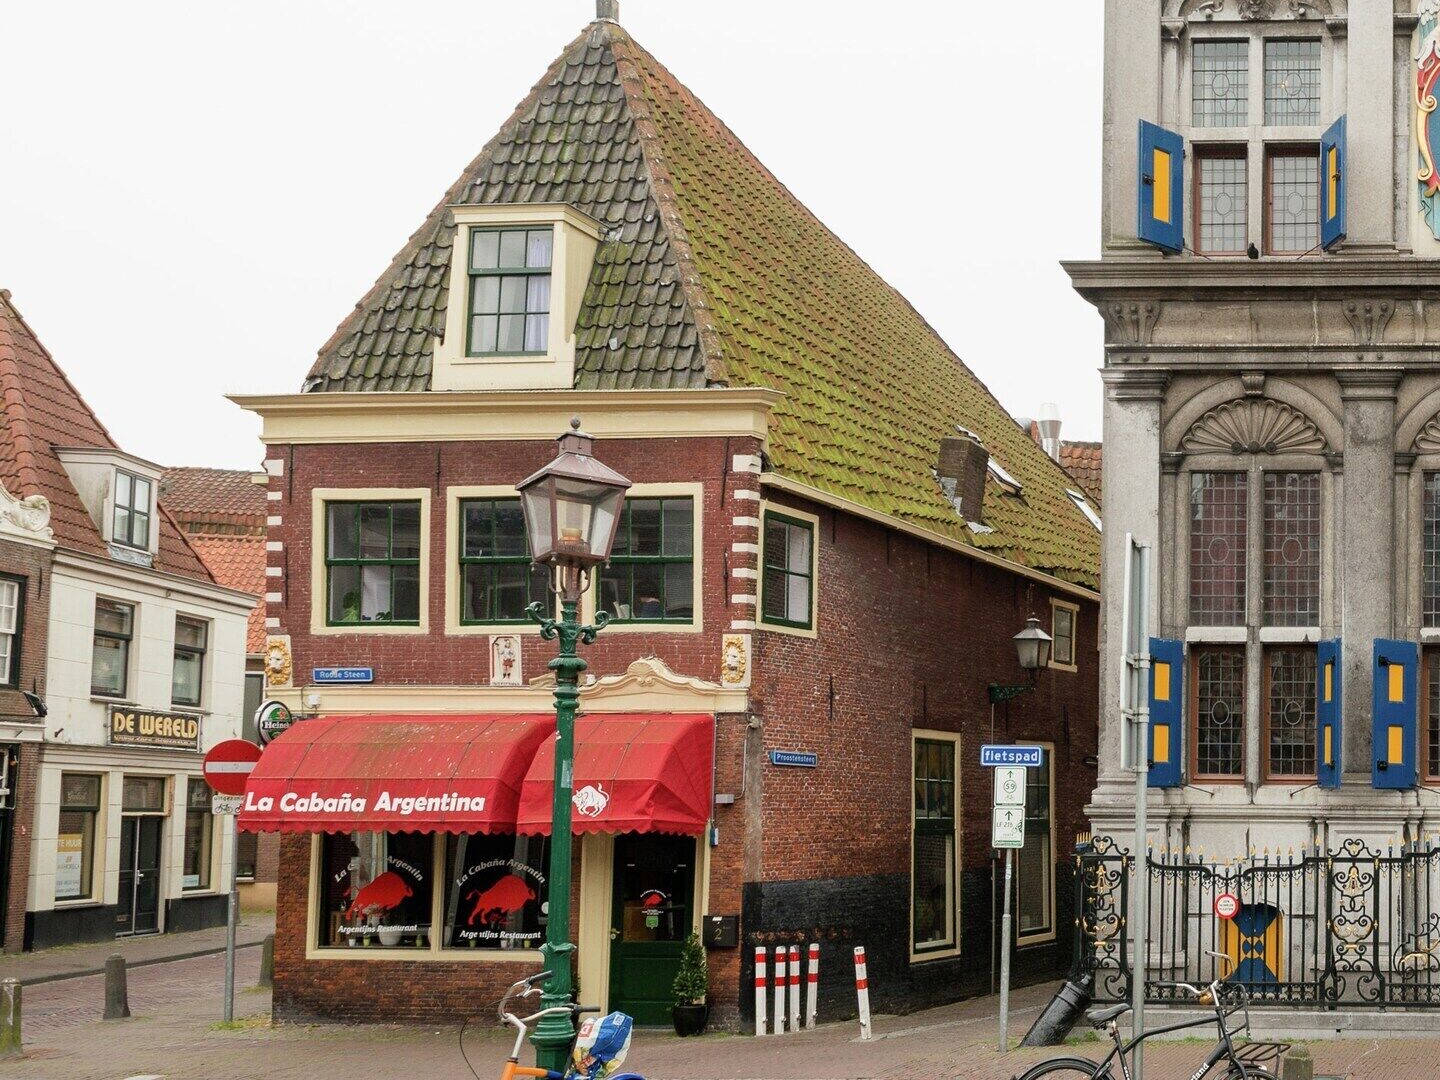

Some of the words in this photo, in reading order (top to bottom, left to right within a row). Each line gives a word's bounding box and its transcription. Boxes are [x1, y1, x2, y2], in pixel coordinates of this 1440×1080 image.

[113, 712, 135, 734] DE
[139, 715, 198, 739] WERELD
[984, 750, 1038, 764] fietspad
[244, 792, 274, 812] La
[279, 792, 367, 813] Cabaña
[374, 791, 486, 815] Argentina
[456, 874, 469, 888] La
[468, 858, 505, 875] Cabaña
[377, 924, 418, 932] Restaurant
[499, 930, 541, 939] Restaurant
